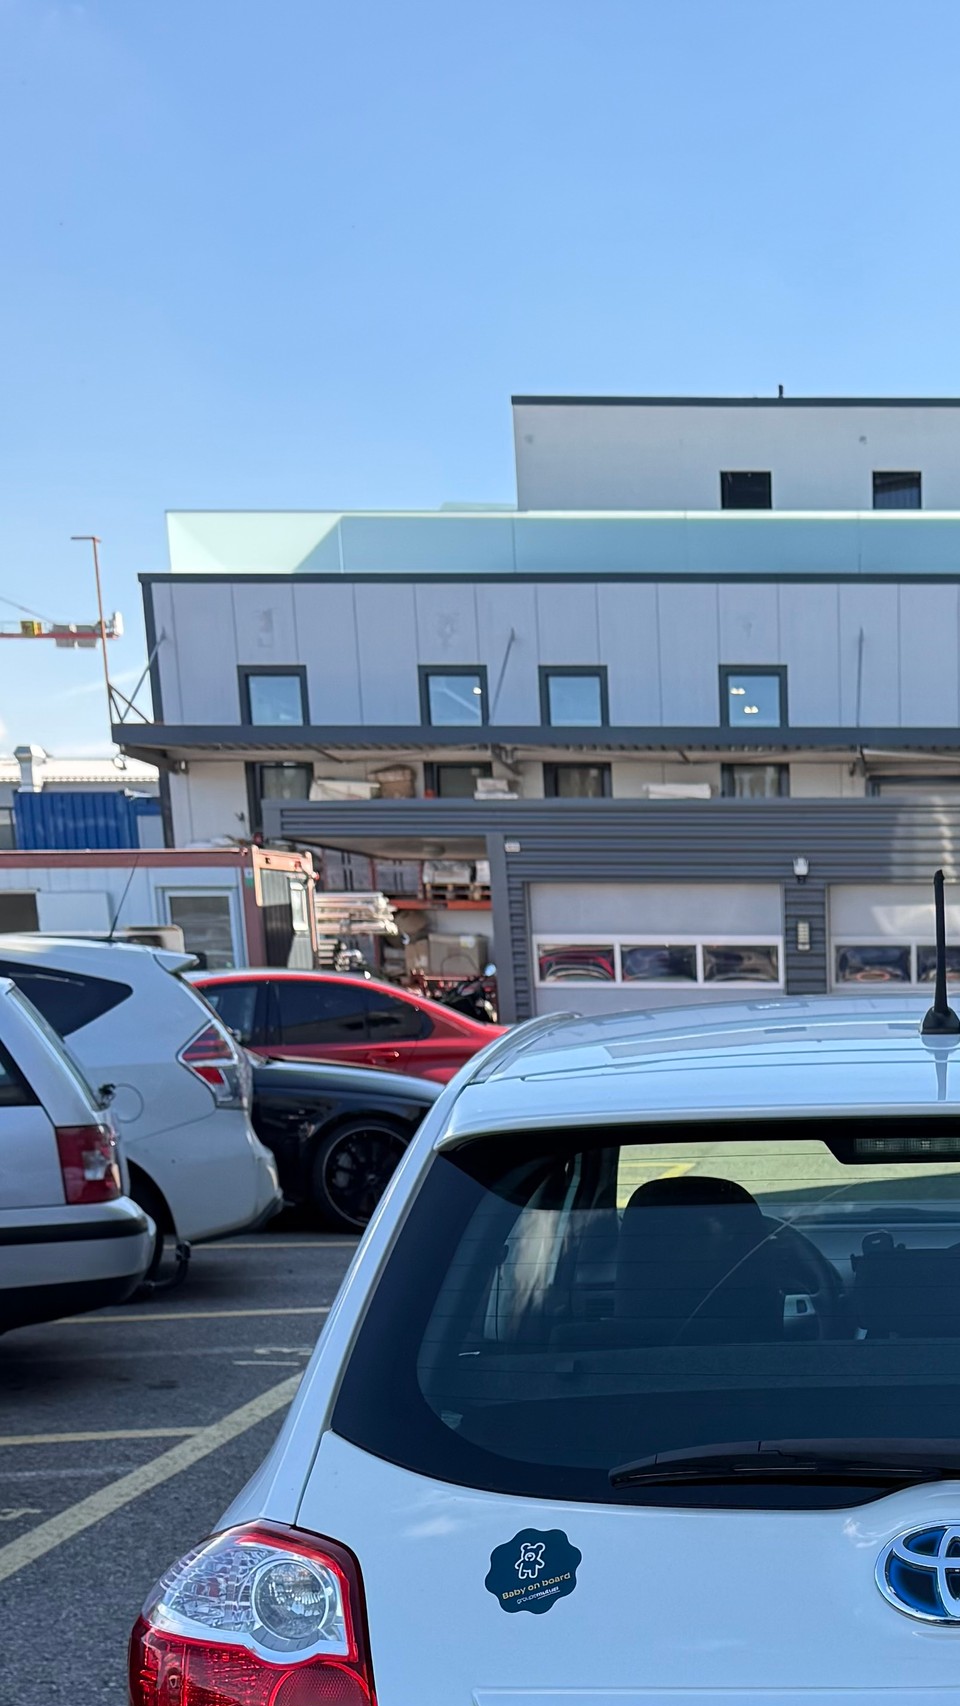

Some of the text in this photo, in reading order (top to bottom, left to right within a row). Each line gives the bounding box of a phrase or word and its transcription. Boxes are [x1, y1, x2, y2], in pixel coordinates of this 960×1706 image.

[502, 1572, 571, 1600] Baby on board
